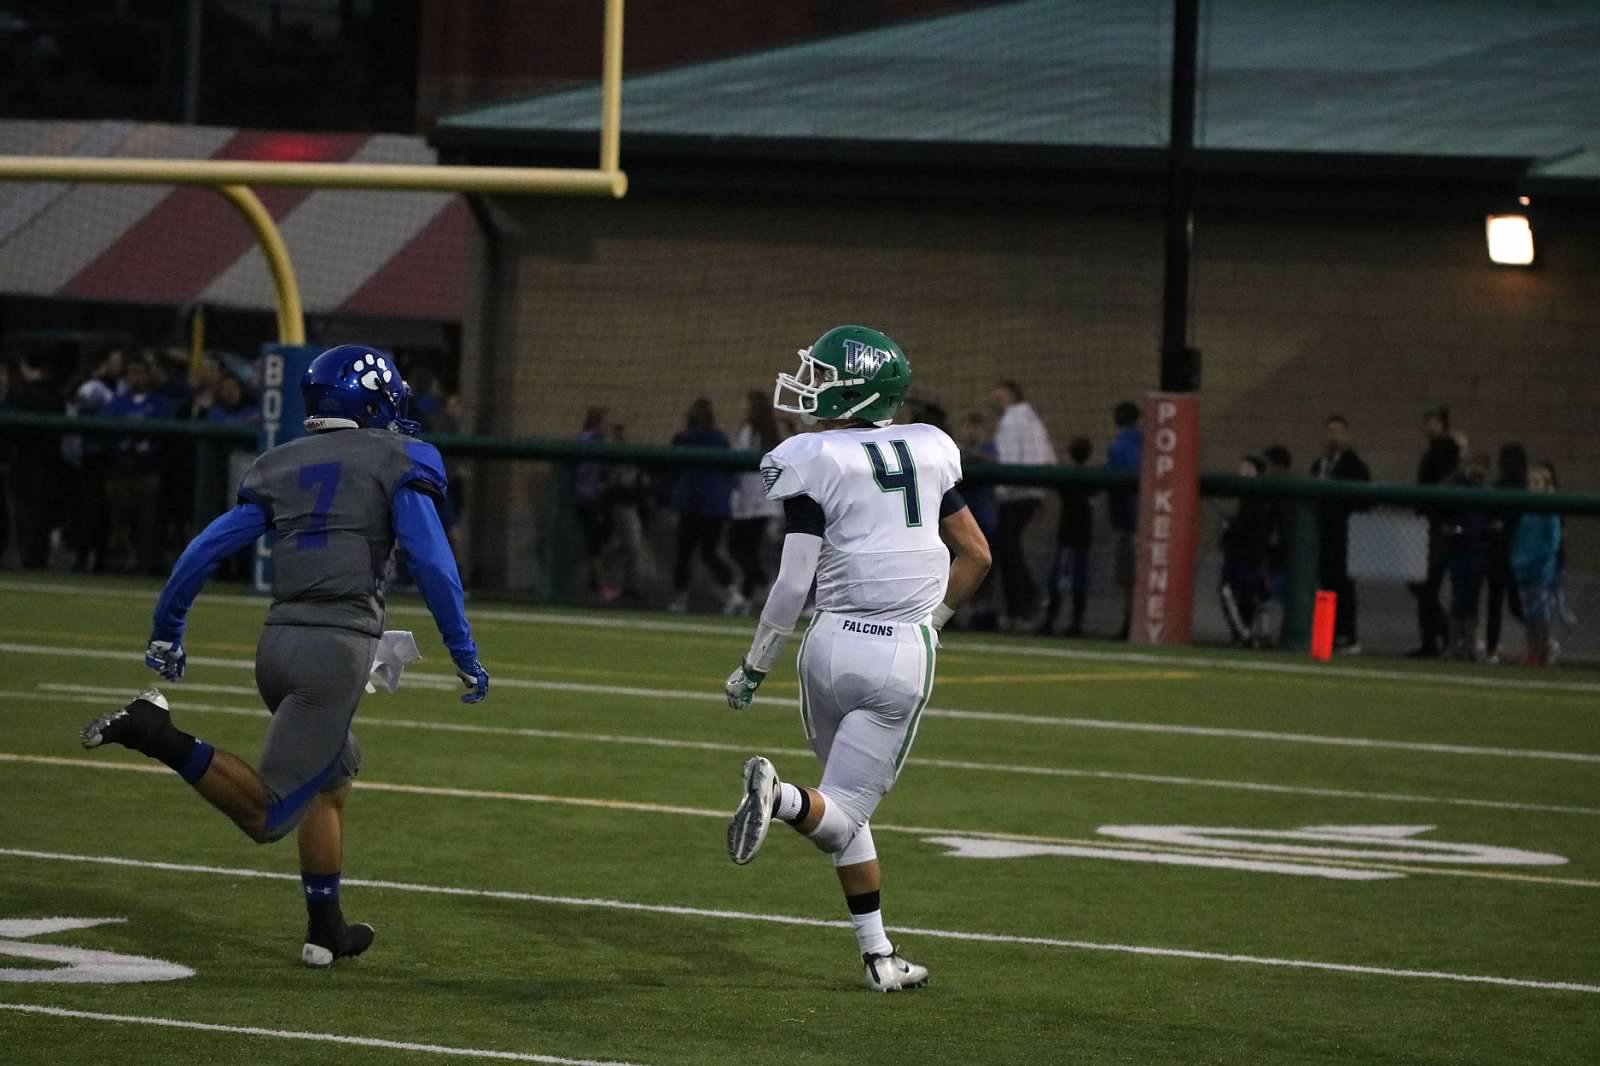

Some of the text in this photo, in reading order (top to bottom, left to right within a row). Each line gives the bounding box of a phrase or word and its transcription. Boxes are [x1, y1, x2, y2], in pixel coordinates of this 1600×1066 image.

[255, 354, 284, 592] BOTLL
[295, 460, 344, 551] 7
[861, 439, 922, 527] 4
[1146, 402, 1177, 643] POP KEENEY
[842, 619, 894, 637] FALCONS
